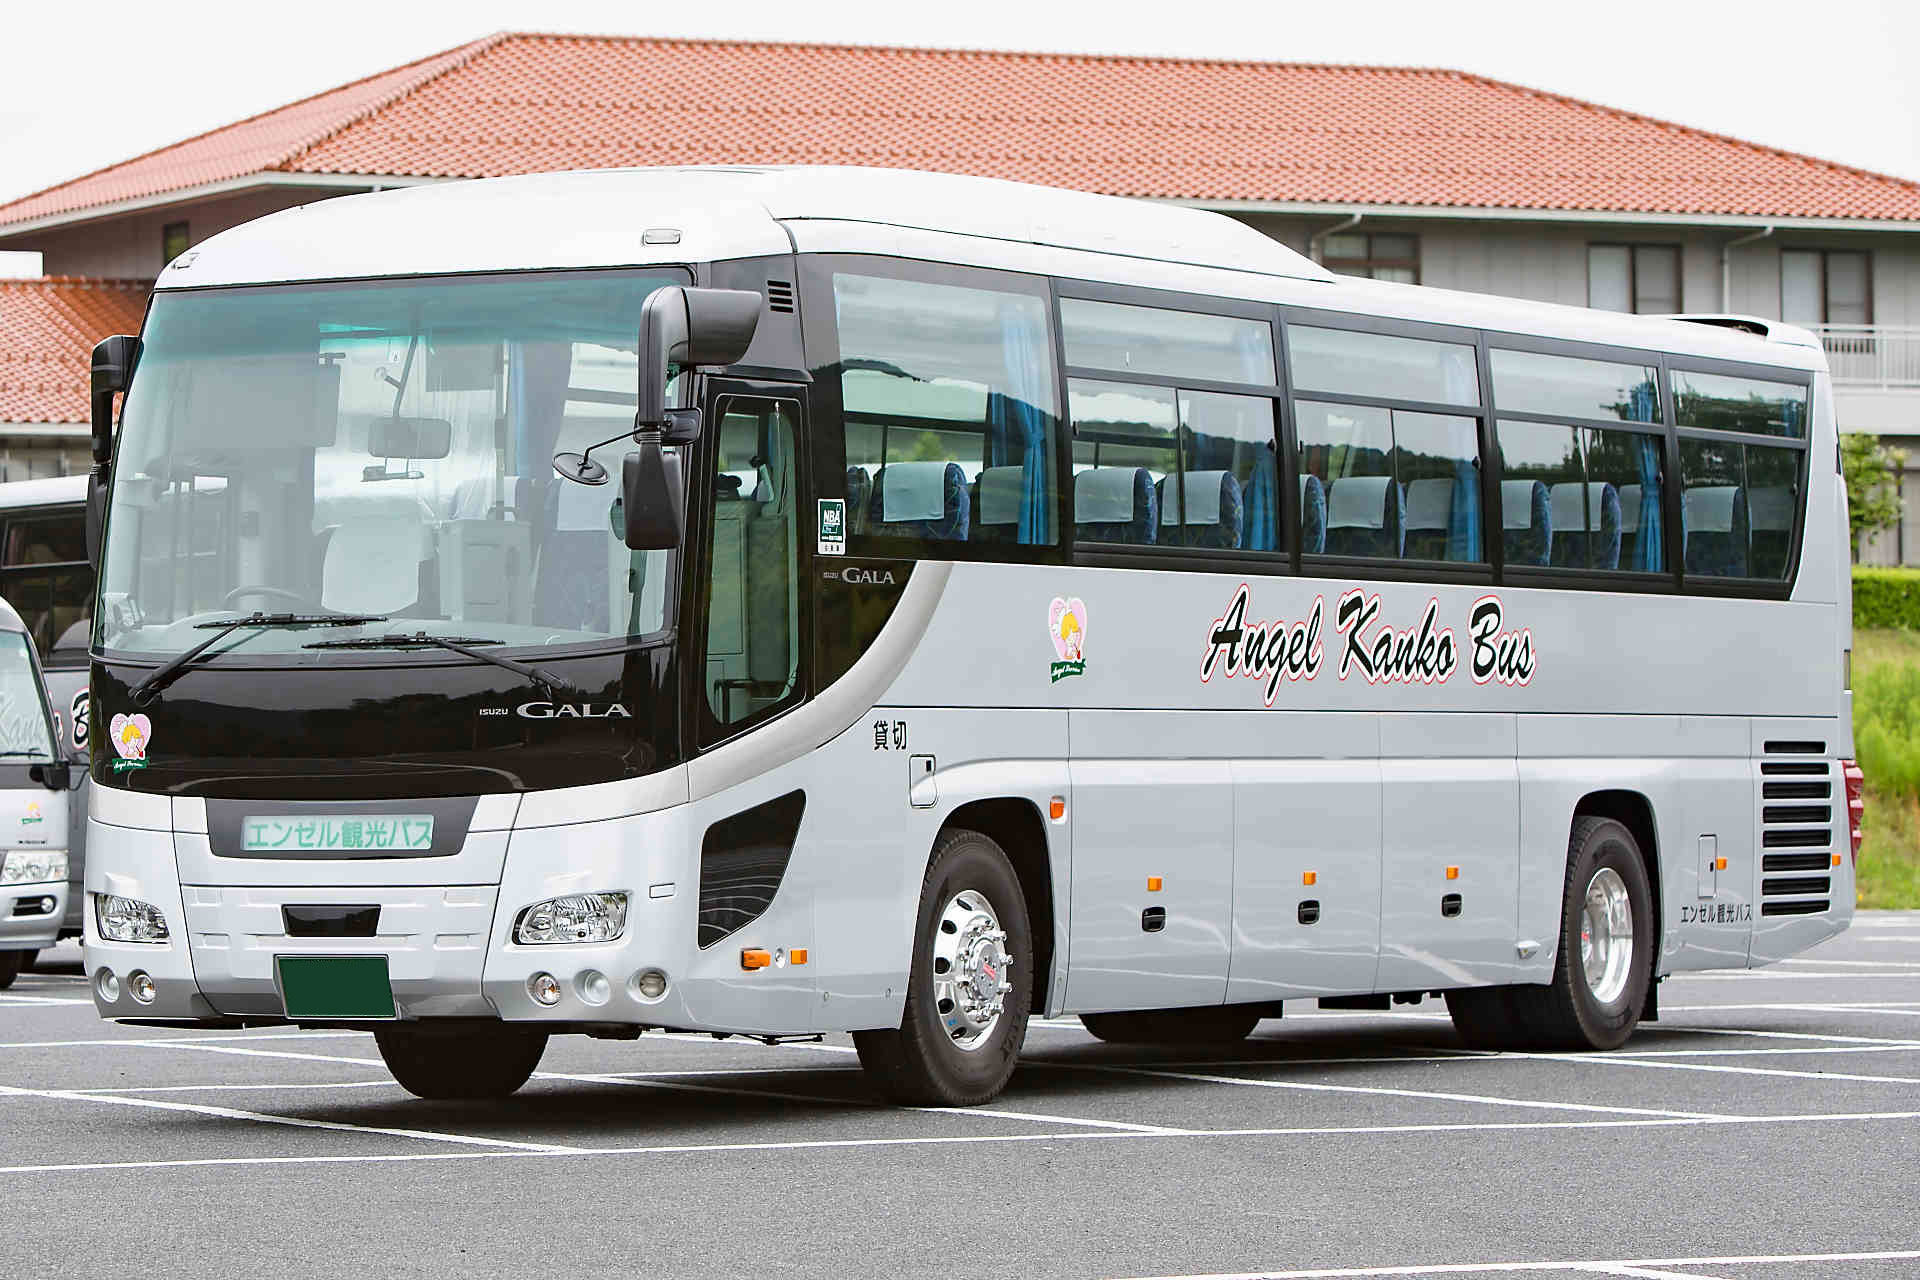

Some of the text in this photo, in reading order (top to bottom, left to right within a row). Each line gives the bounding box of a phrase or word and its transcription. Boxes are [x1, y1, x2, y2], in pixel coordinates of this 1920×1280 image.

[823, 509, 841, 524] NBA
[841, 567, 896, 585] GALA
[1201, 584, 1535, 706] Angel Kanko Bus
[479, 701, 633, 719] ISUZU GALA
[873, 719, 907, 751] 貸切
[247, 819, 433, 849] エンゼル観光バス
[1680, 903, 1753, 924] エンゼル観光バス
